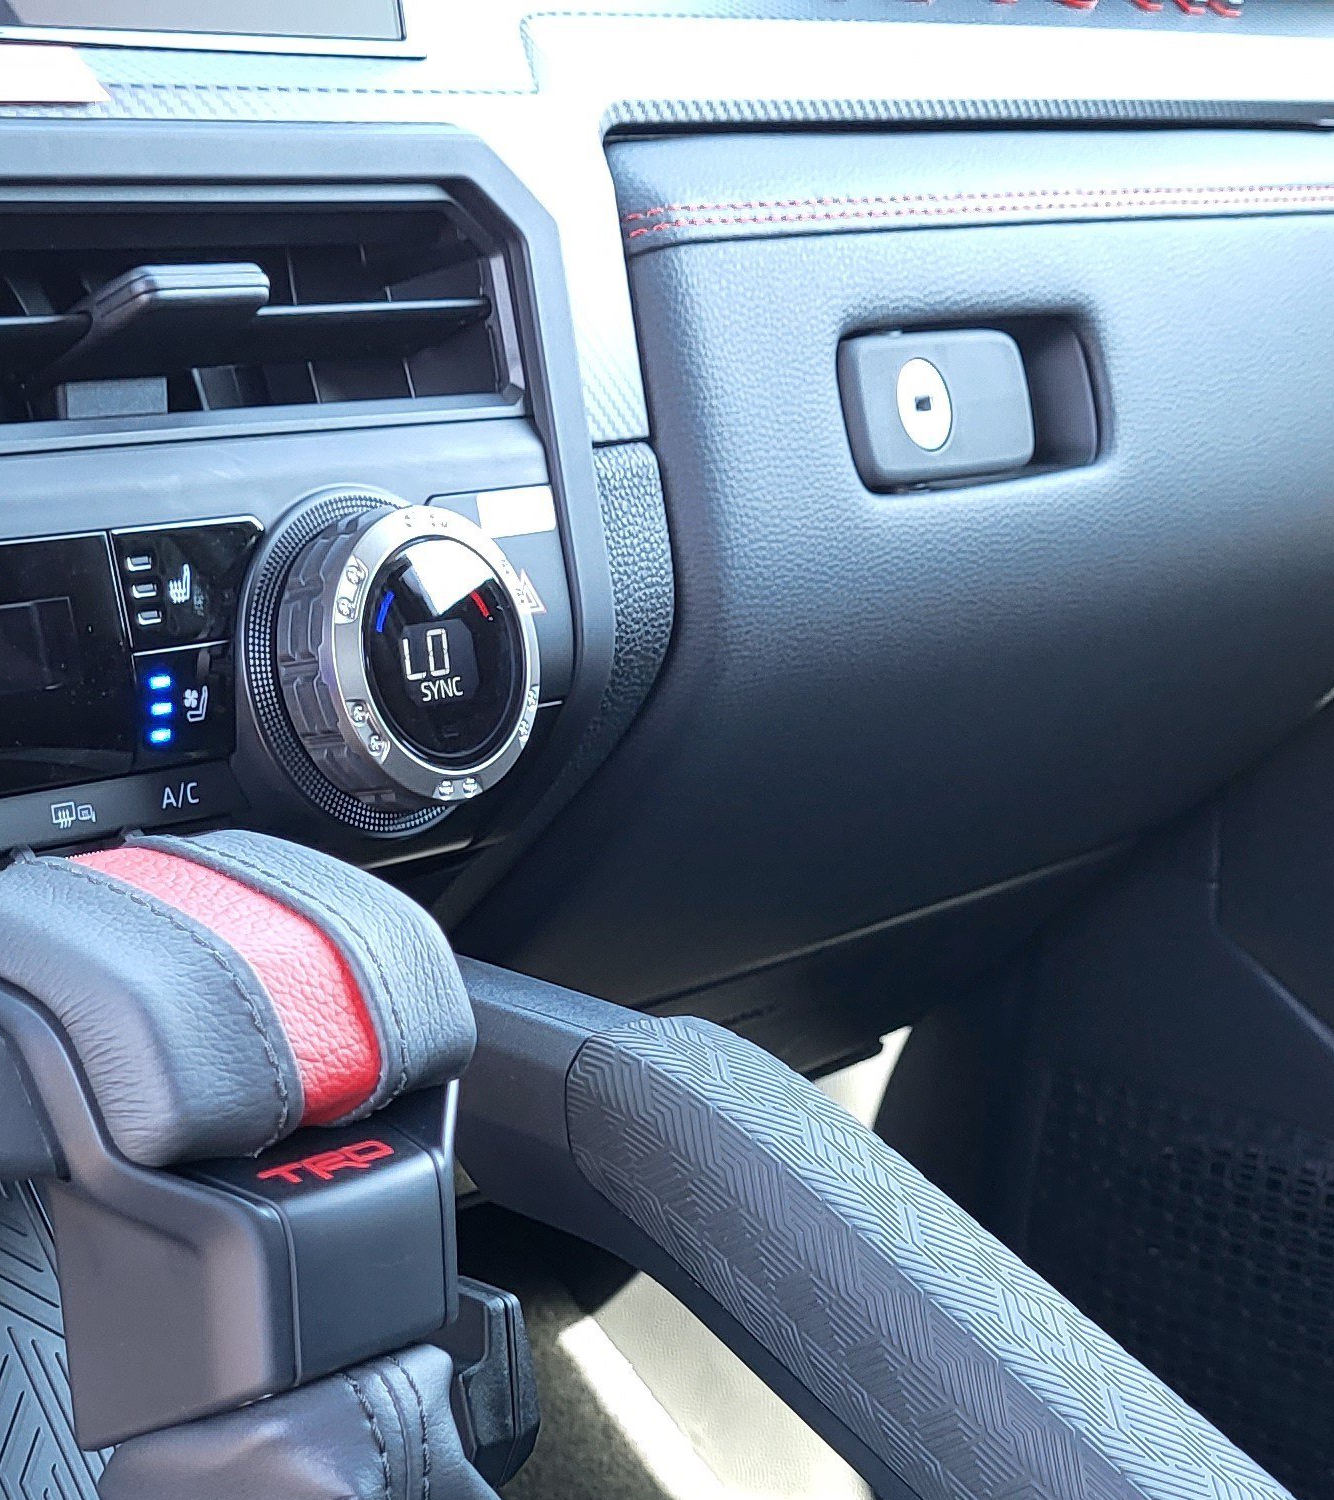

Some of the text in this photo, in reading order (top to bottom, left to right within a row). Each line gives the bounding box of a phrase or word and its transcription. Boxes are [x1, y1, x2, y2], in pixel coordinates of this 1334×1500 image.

[400, 627, 452, 681] LO
[420, 676, 464, 702] SYNC
[160, 780, 201, 810] A/C
[256, 1139, 395, 1184] TRD
